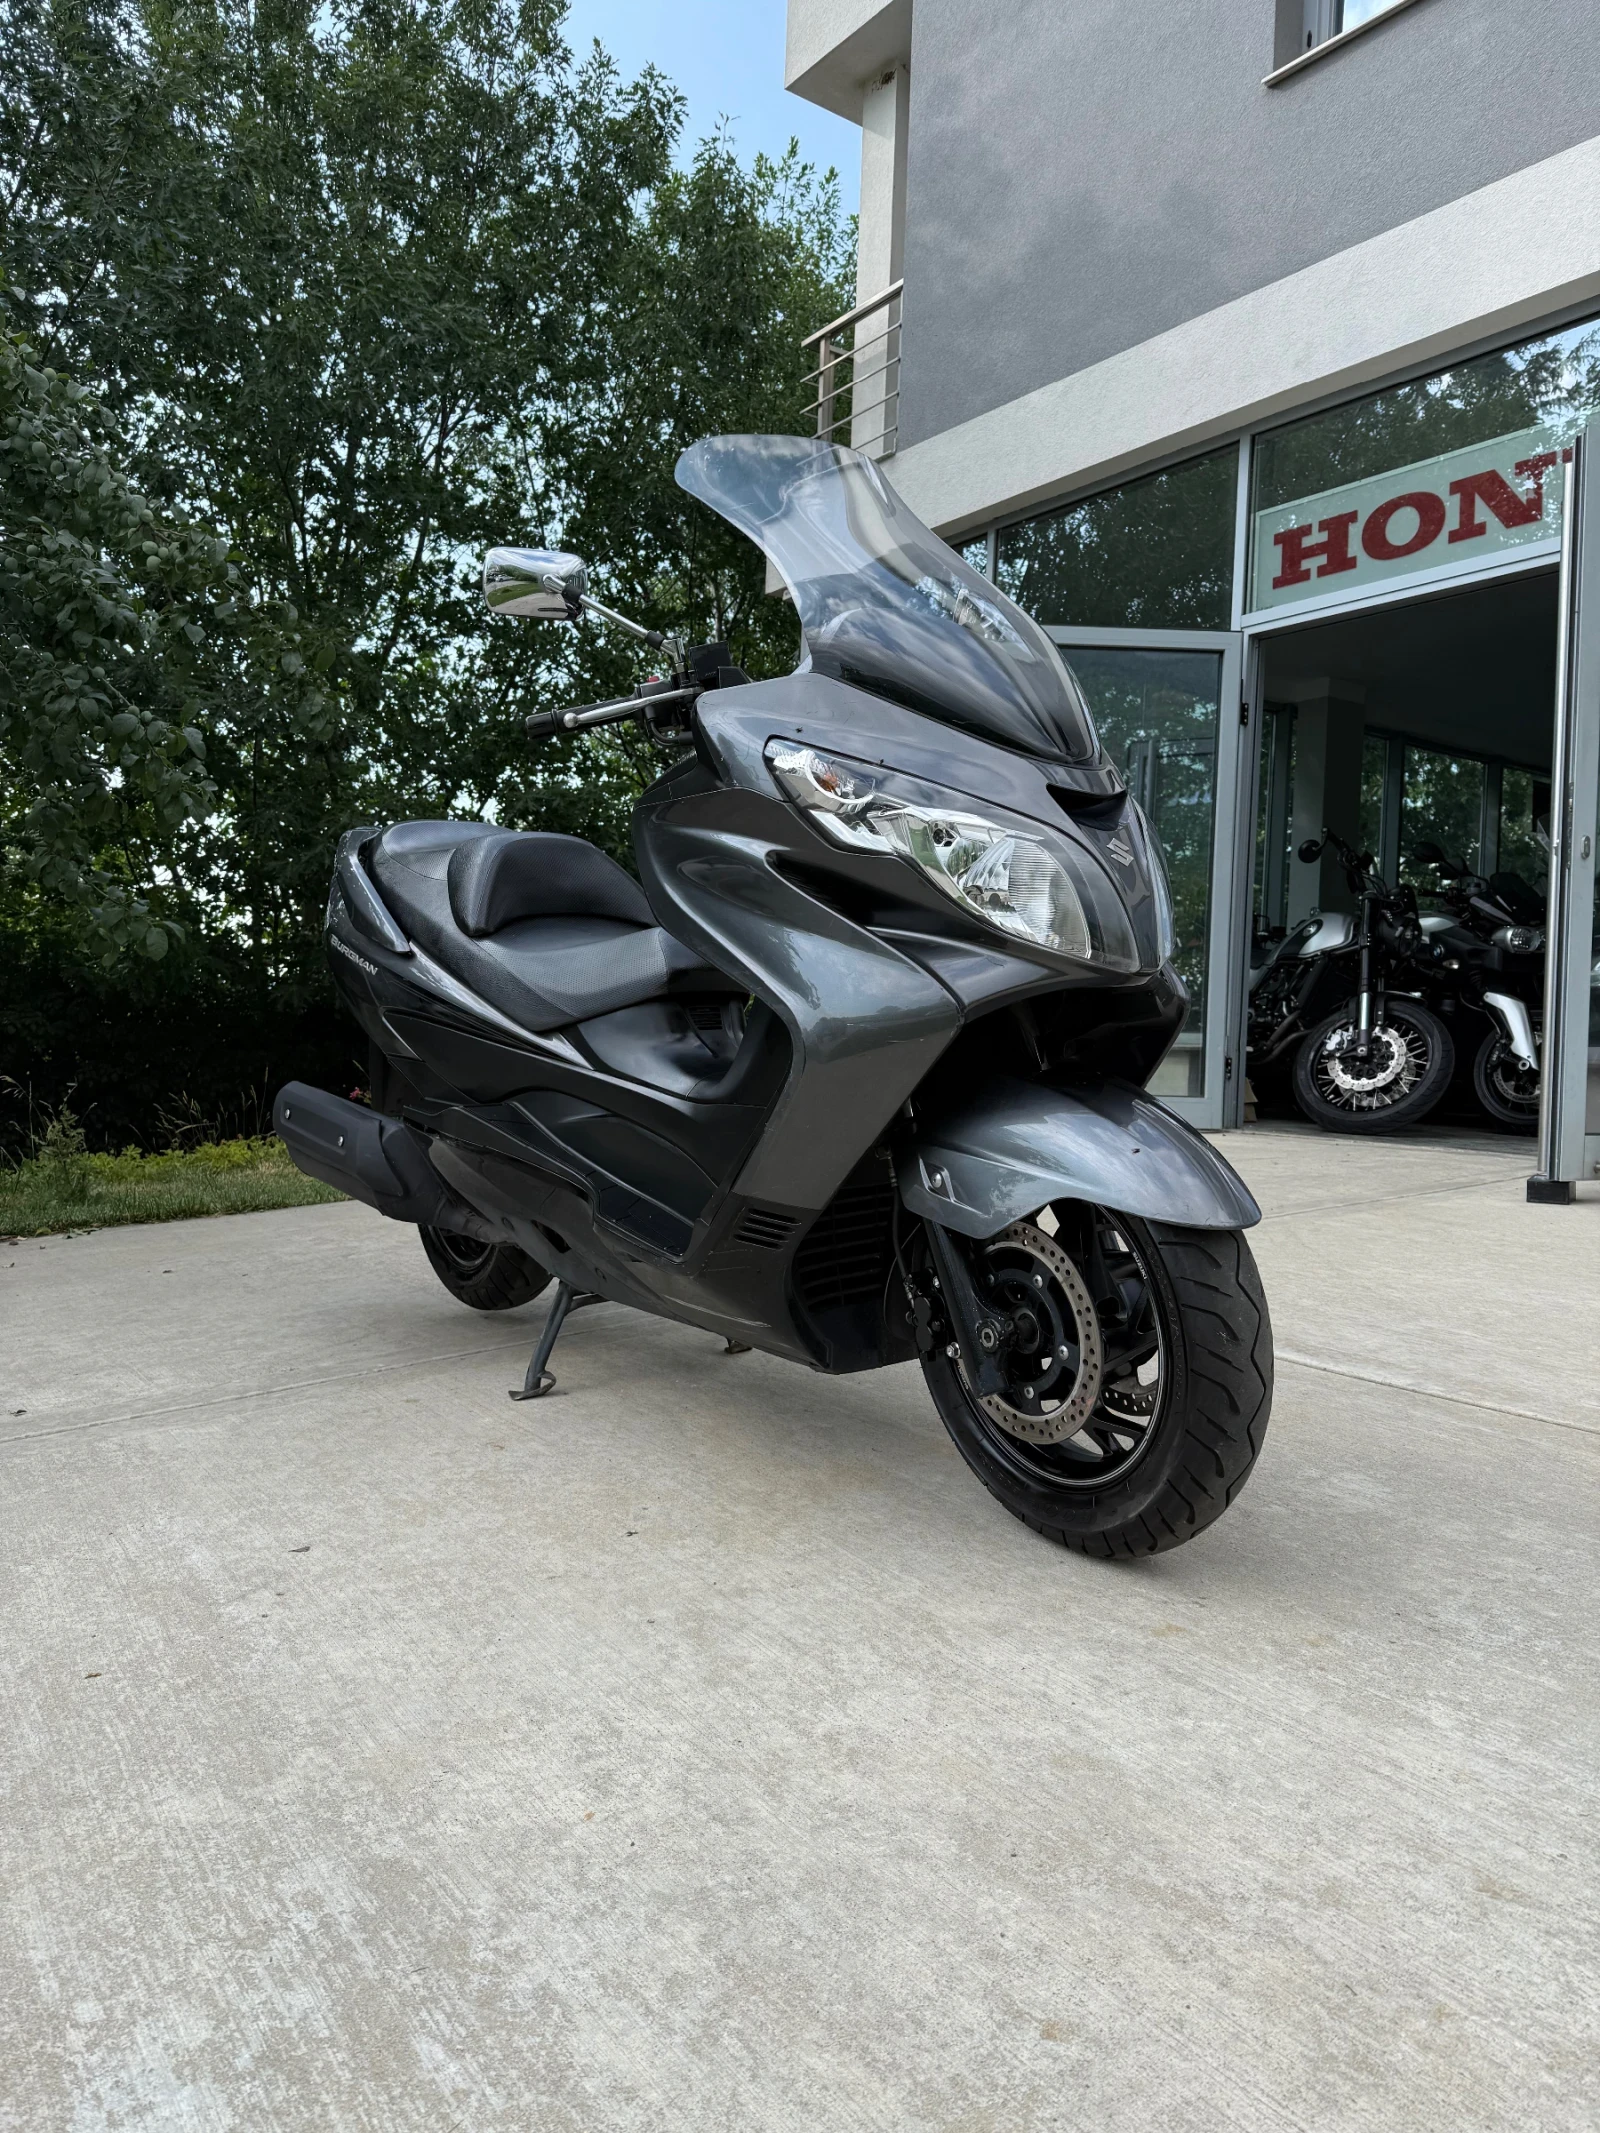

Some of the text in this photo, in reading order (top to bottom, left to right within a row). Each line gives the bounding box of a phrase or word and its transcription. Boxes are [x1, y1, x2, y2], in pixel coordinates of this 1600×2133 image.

[1272, 447, 1573, 590] HON
[330, 934, 378, 975] BURGMAN
[1132, 1251, 1148, 1280] SUZUKI
